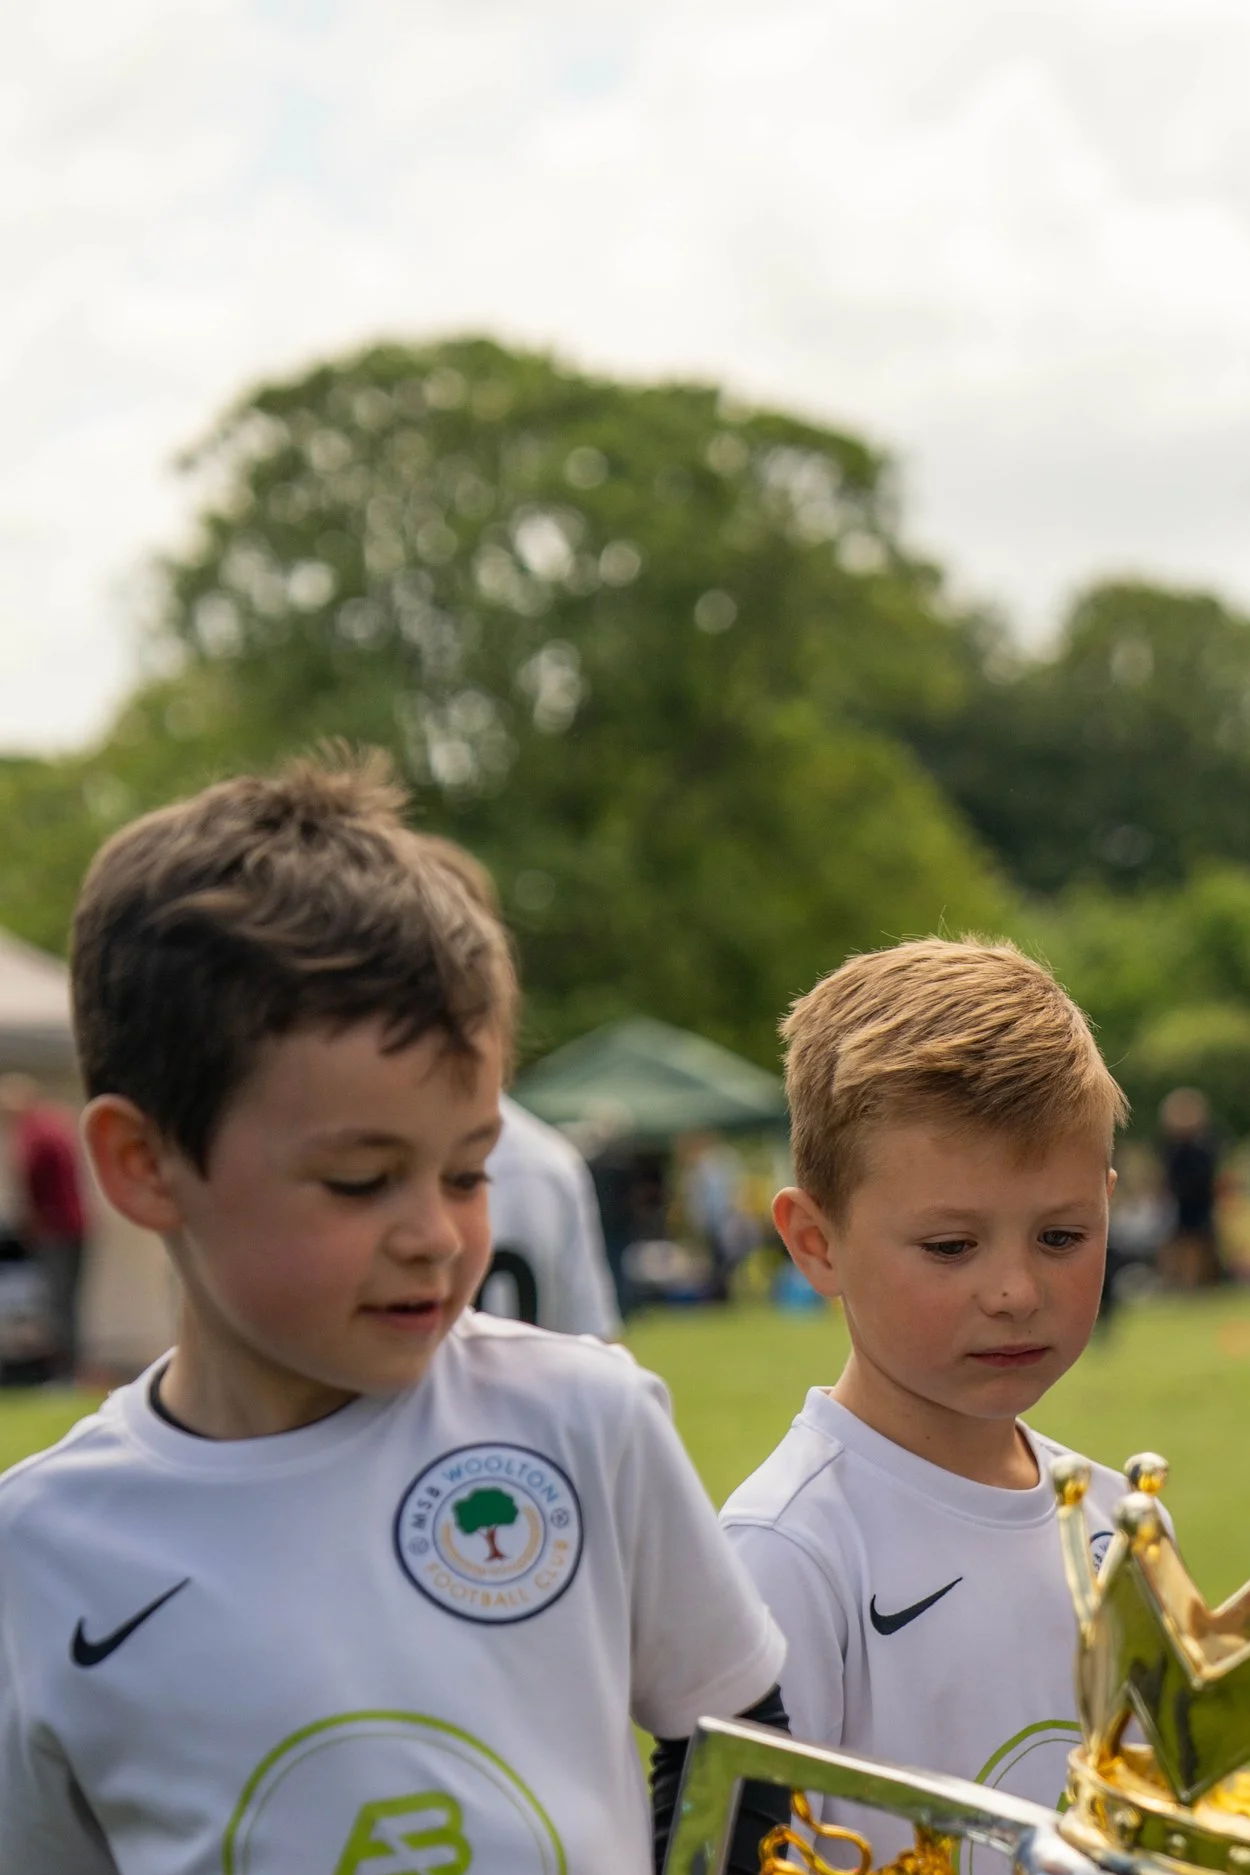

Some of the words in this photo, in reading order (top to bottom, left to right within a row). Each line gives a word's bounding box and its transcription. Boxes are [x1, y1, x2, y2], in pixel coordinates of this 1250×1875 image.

[411, 1485, 441, 1529] MSB
[441, 1455, 559, 1503] WOOLTON
[425, 1561, 529, 1608] FOOTBALL
[534, 1538, 570, 1590] CLUB
